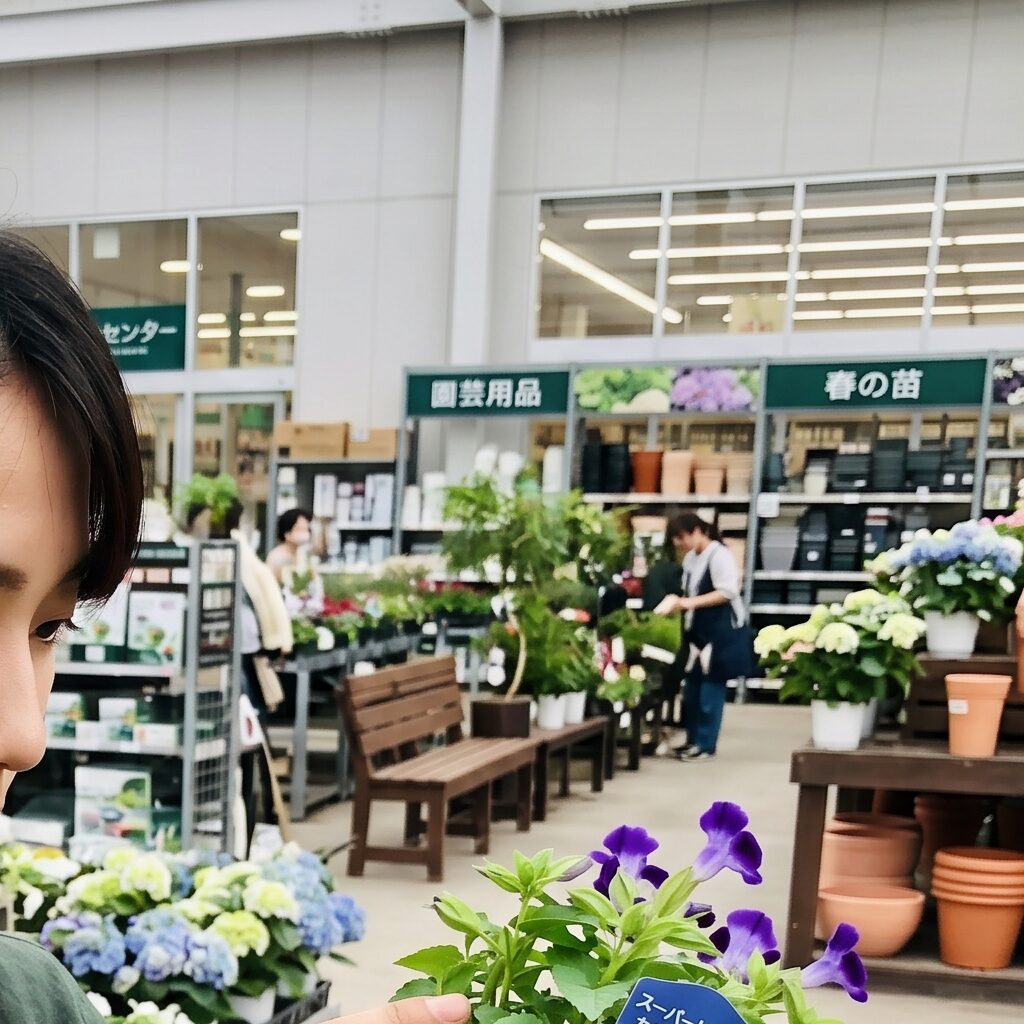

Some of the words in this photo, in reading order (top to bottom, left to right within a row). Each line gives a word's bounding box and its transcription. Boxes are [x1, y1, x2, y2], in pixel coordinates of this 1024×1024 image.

[431, 377, 542, 408] 園芸用品
[824, 367, 923, 400] 春の苗
